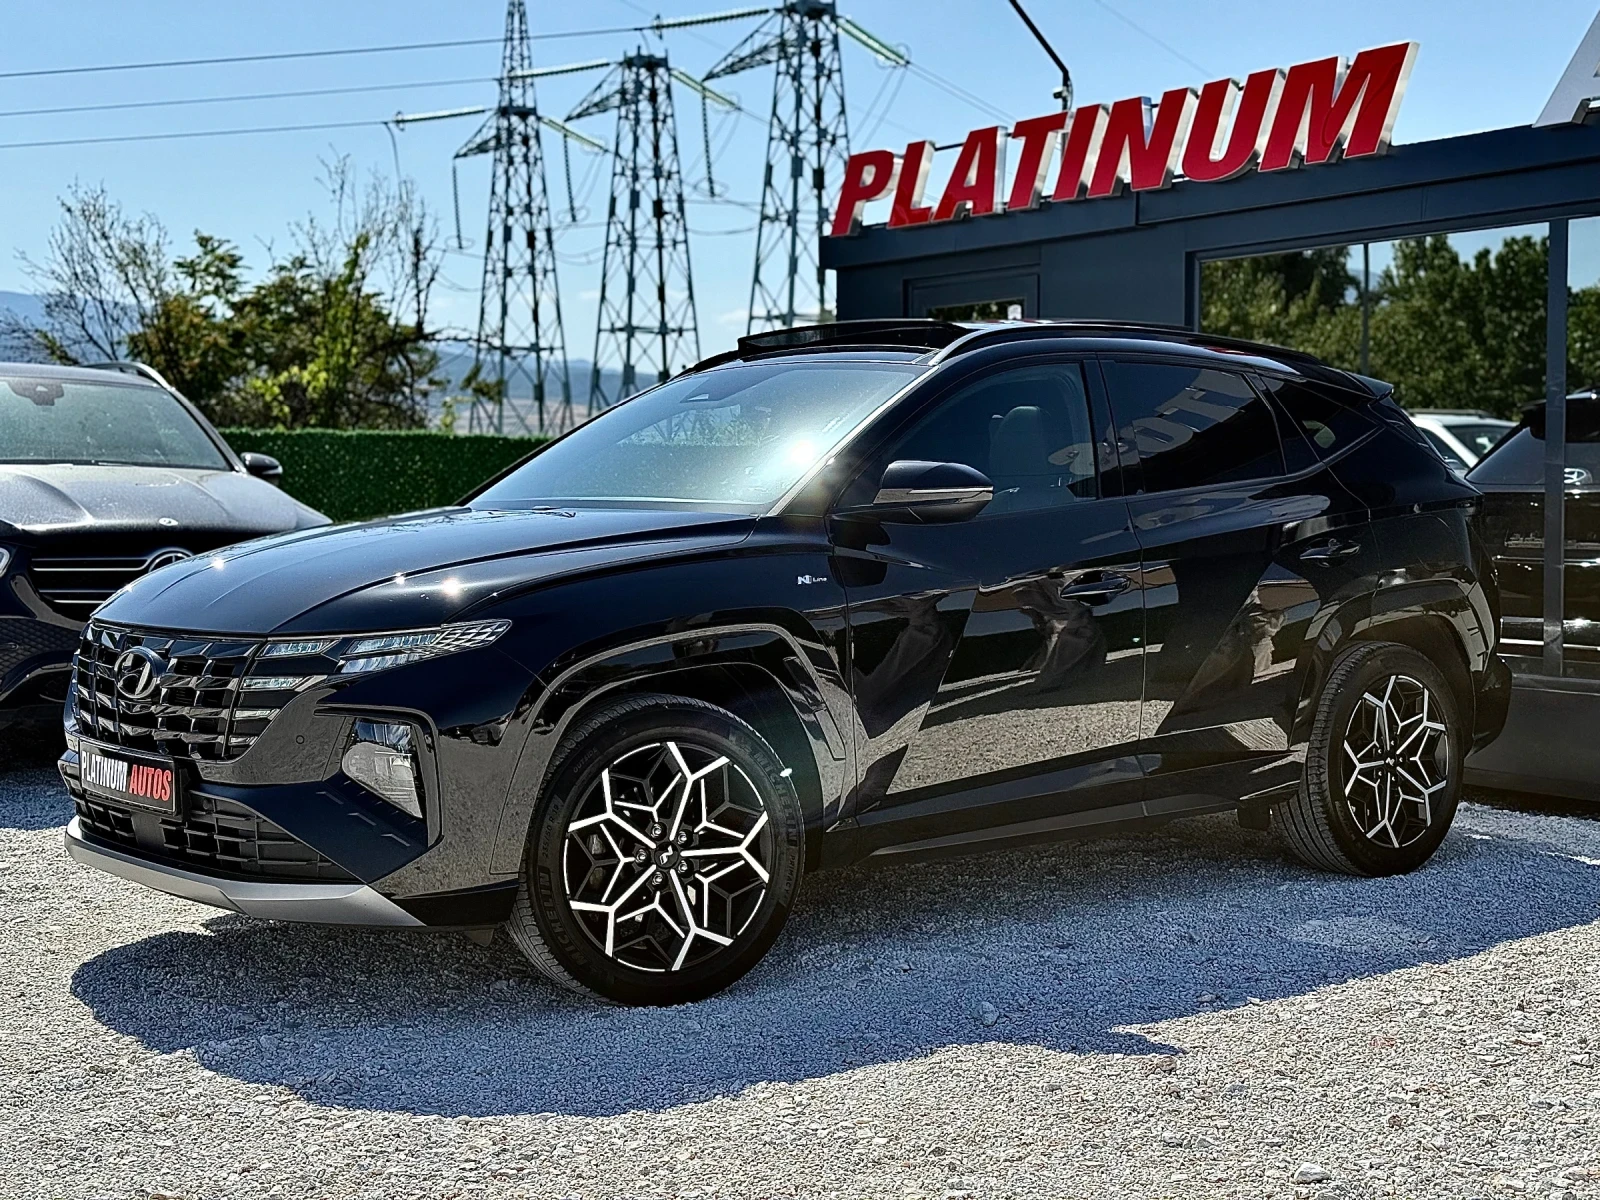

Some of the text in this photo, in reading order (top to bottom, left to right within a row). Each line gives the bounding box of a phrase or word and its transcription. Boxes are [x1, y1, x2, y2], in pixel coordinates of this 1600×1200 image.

[831, 42, 1418, 236] PLATINUM
[81, 750, 172, 802] PLATINUM AUTOS
[573, 747, 598, 773] OUTSIDE
[753, 752, 798, 847] MICHELIN
[784, 854, 796, 894] PRIMACY
[538, 871, 588, 967] MICHELIN
